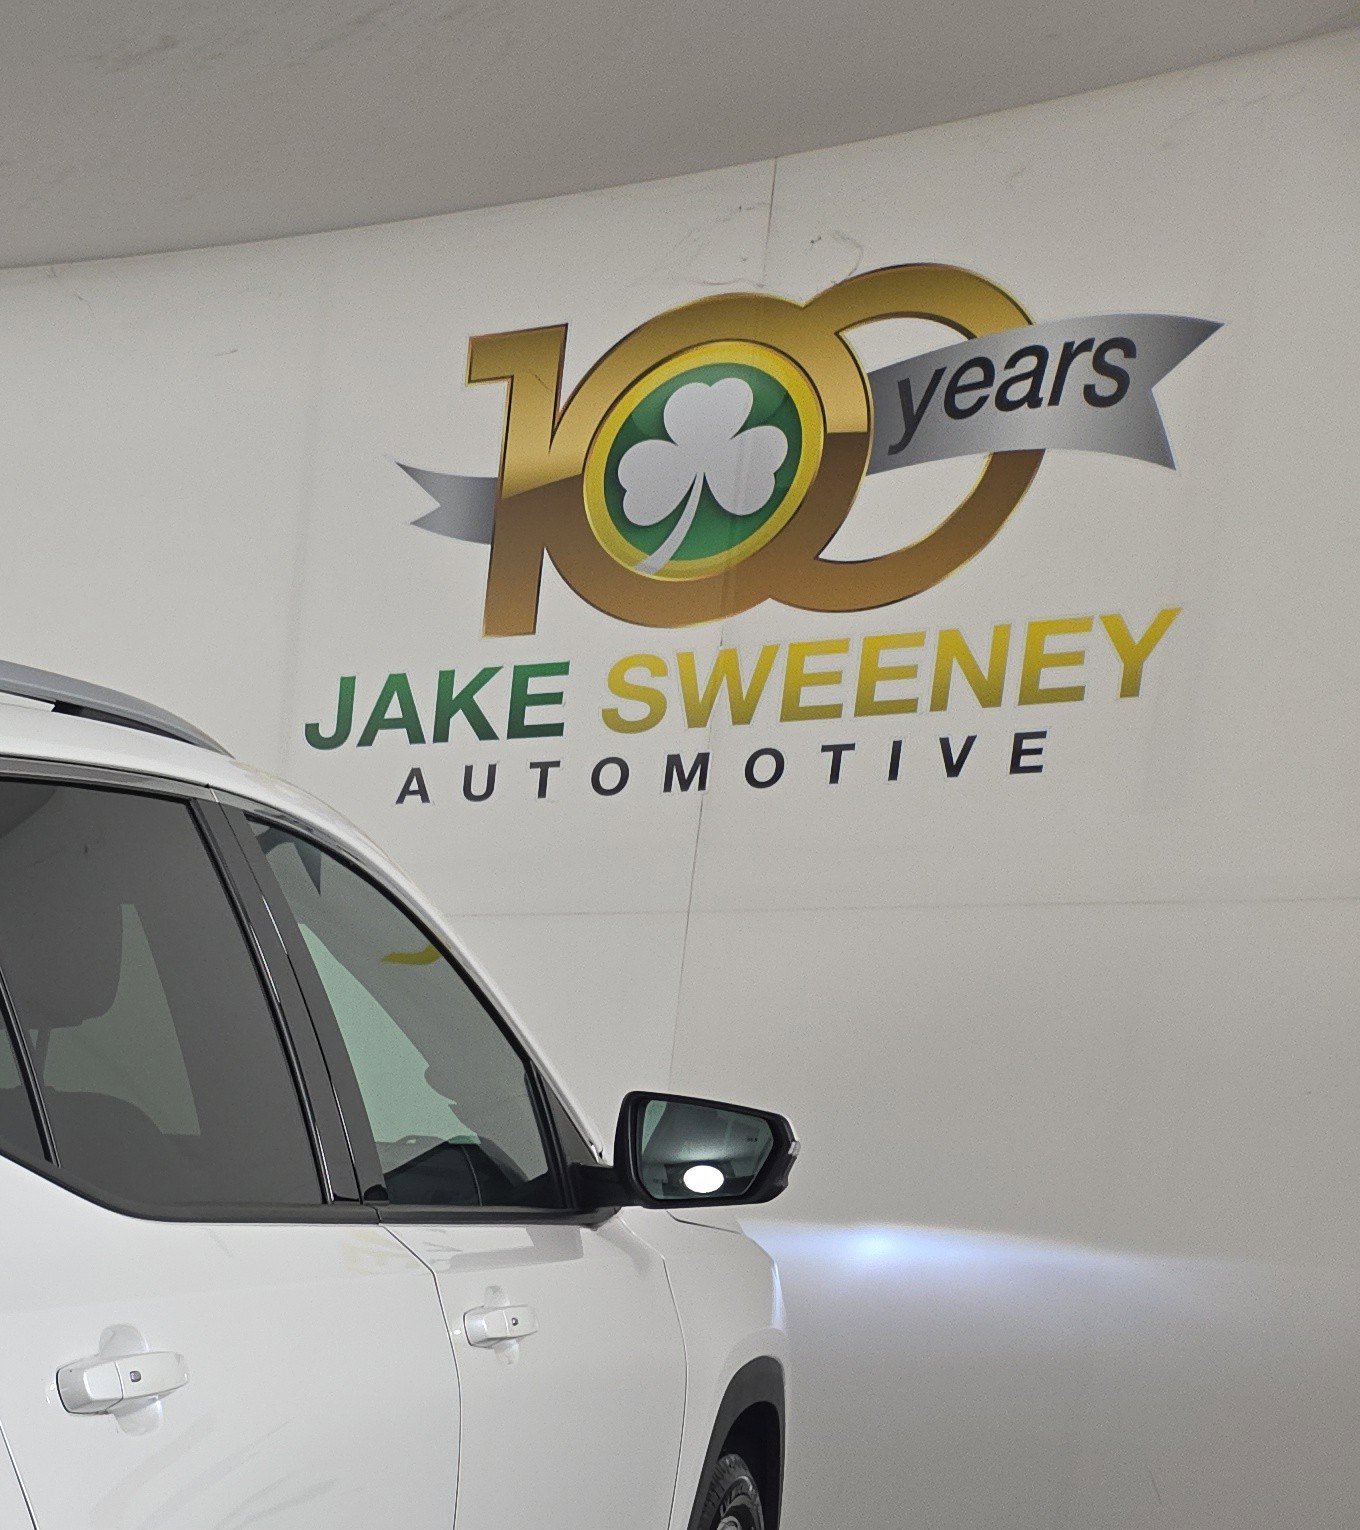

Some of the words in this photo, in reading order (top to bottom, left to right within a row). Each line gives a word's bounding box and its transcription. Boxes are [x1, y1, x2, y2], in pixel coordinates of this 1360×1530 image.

[466, 263, 1049, 637] 100
[887, 335, 1136, 456] years
[304, 660, 570, 751] JAKE
[601, 606, 1183, 735] SWEENEY
[396, 729, 1047, 805] AUTOMOTIVE
